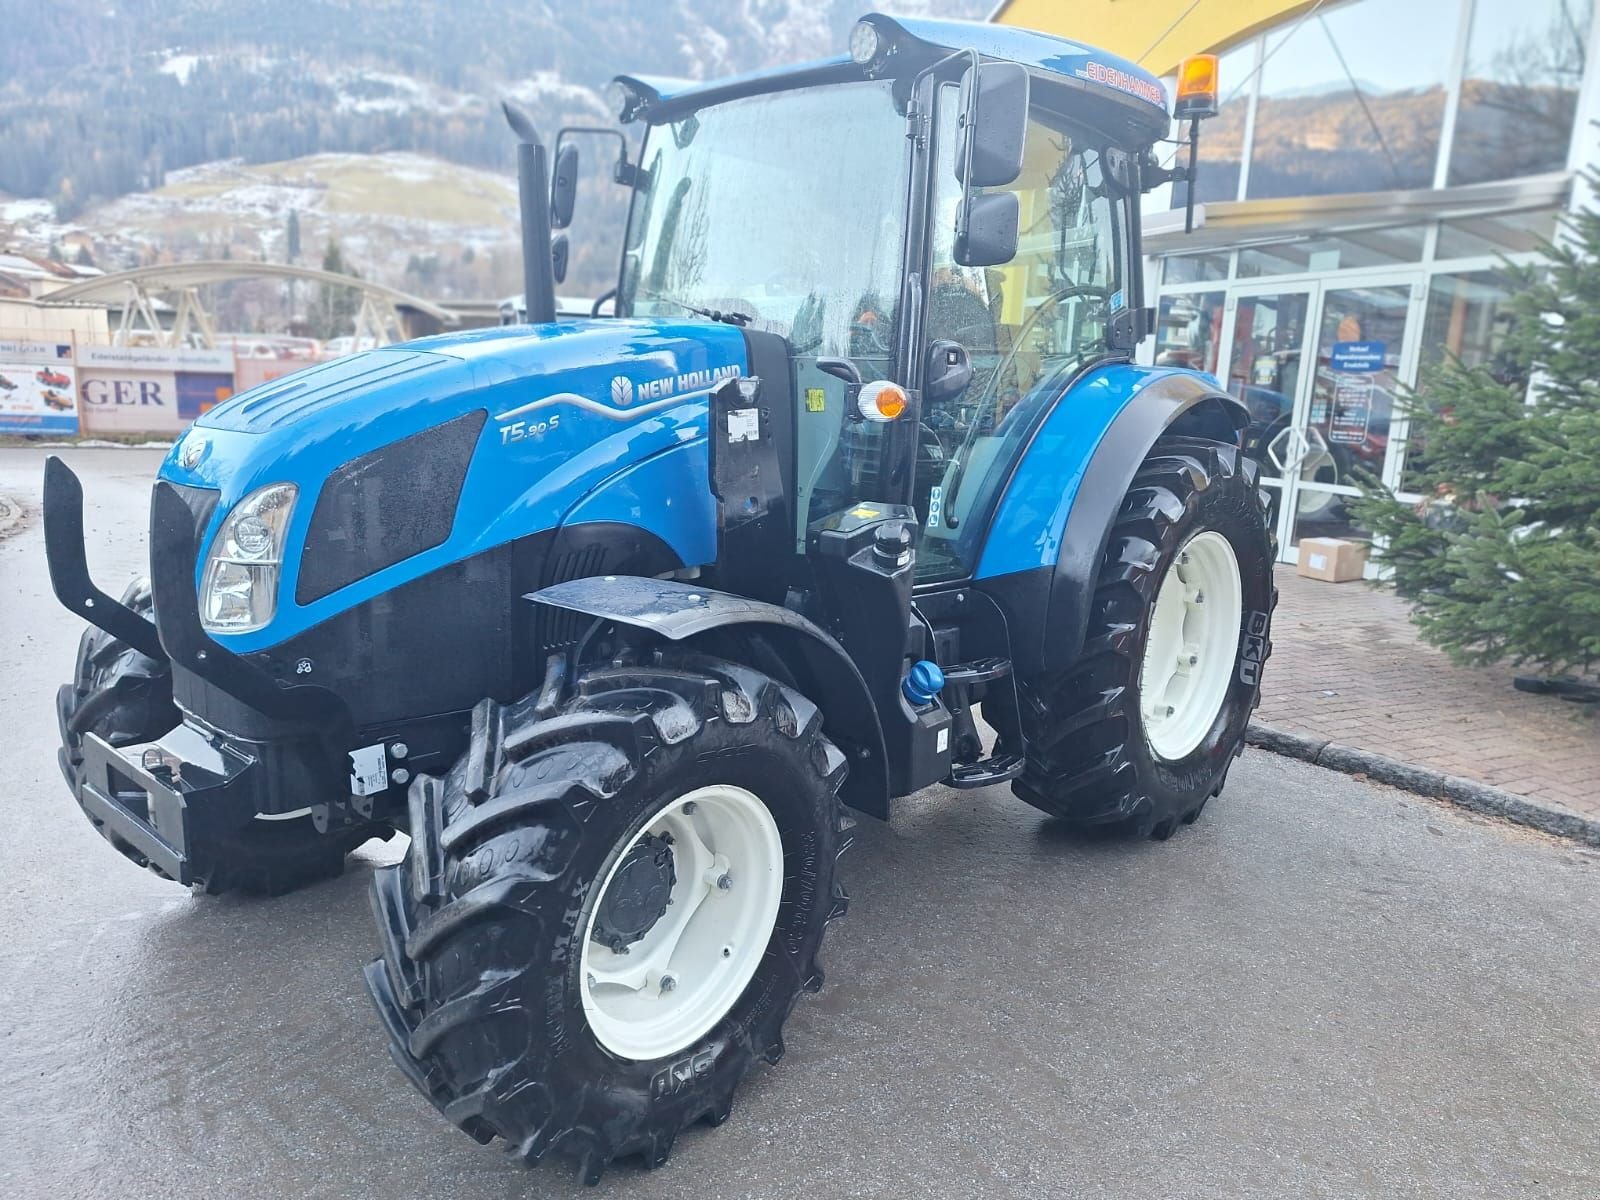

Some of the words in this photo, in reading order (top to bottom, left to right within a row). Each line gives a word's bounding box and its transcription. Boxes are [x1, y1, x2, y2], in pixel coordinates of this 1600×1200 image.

[80, 379, 165, 407] GER
[637, 376, 674, 400] NEW
[677, 364, 741, 391] HOLLAND
[1240, 610, 1268, 686] BKT
